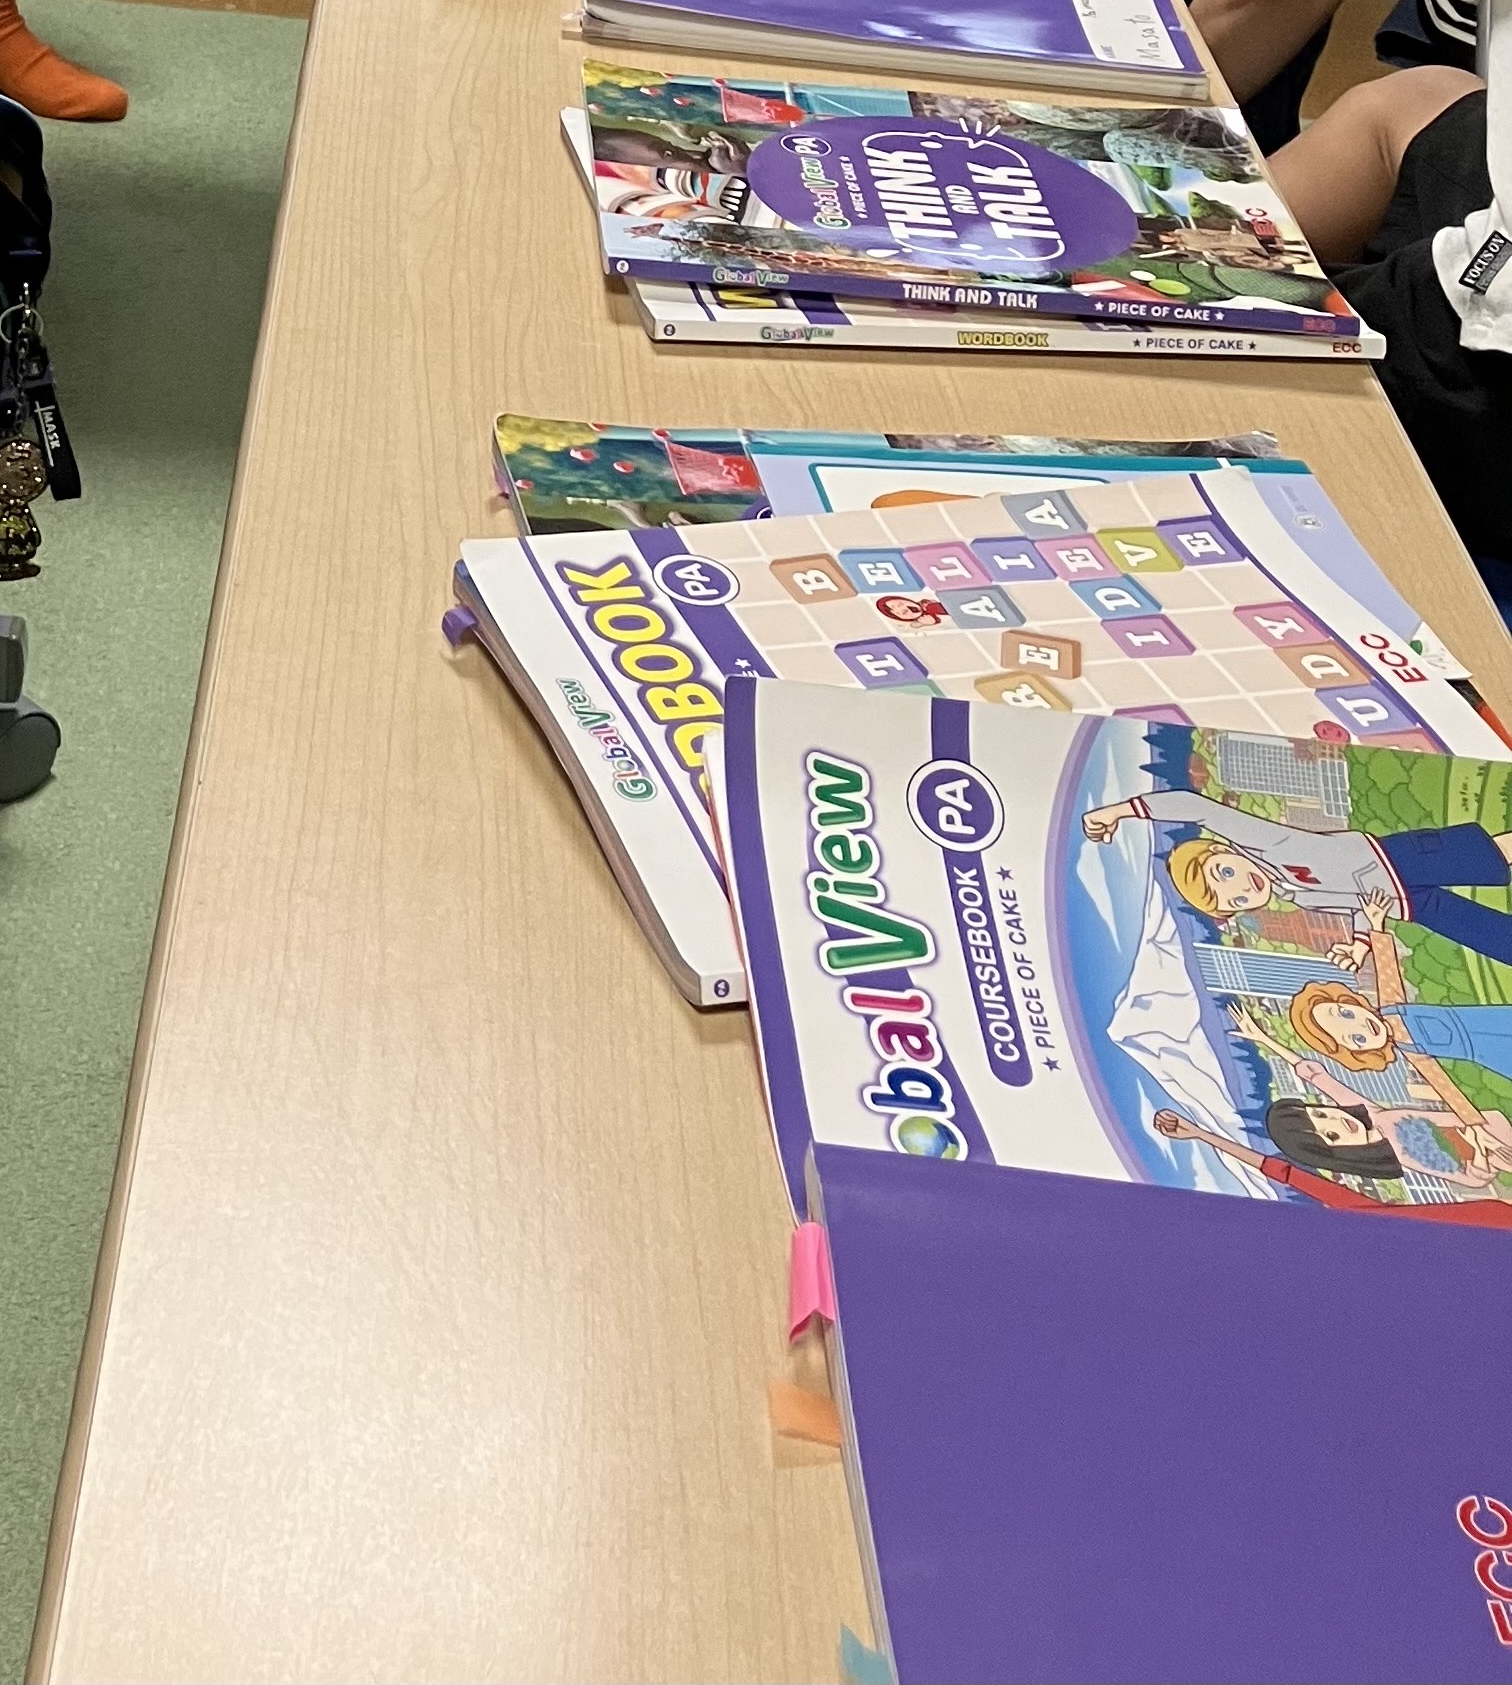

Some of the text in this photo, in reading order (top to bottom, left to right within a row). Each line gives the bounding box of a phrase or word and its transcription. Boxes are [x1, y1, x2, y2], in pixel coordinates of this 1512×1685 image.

[791, 136, 821, 155] PA
[863, 147, 959, 240] THINK
[945, 185, 980, 215] AND
[966, 162, 1062, 240] TALK
[901, 283, 951, 302] THINK
[954, 287, 991, 305] AND
[997, 291, 1038, 309] TALK
[1108, 300, 1148, 316] PIECE
[1151, 303, 1171, 318] OF
[1174, 306, 1210, 322] CAKE
[957, 330, 1050, 348] WORDBOOK
[1145, 336, 1185, 350] PIECE
[1187, 337, 1205, 350] OF
[1206, 337, 1244, 352] CAKE
[1332, 341, 1362, 354] ECC
[563, 561, 725, 768] DBOOK PA
[1359, 632, 1430, 684] ECC
[557, 679, 656, 801] Global View
[813, 760, 930, 970] View
[938, 778, 1023, 1064] COURSEBOOK PA
[999, 885, 1055, 1053] PIECE OF CAKE
